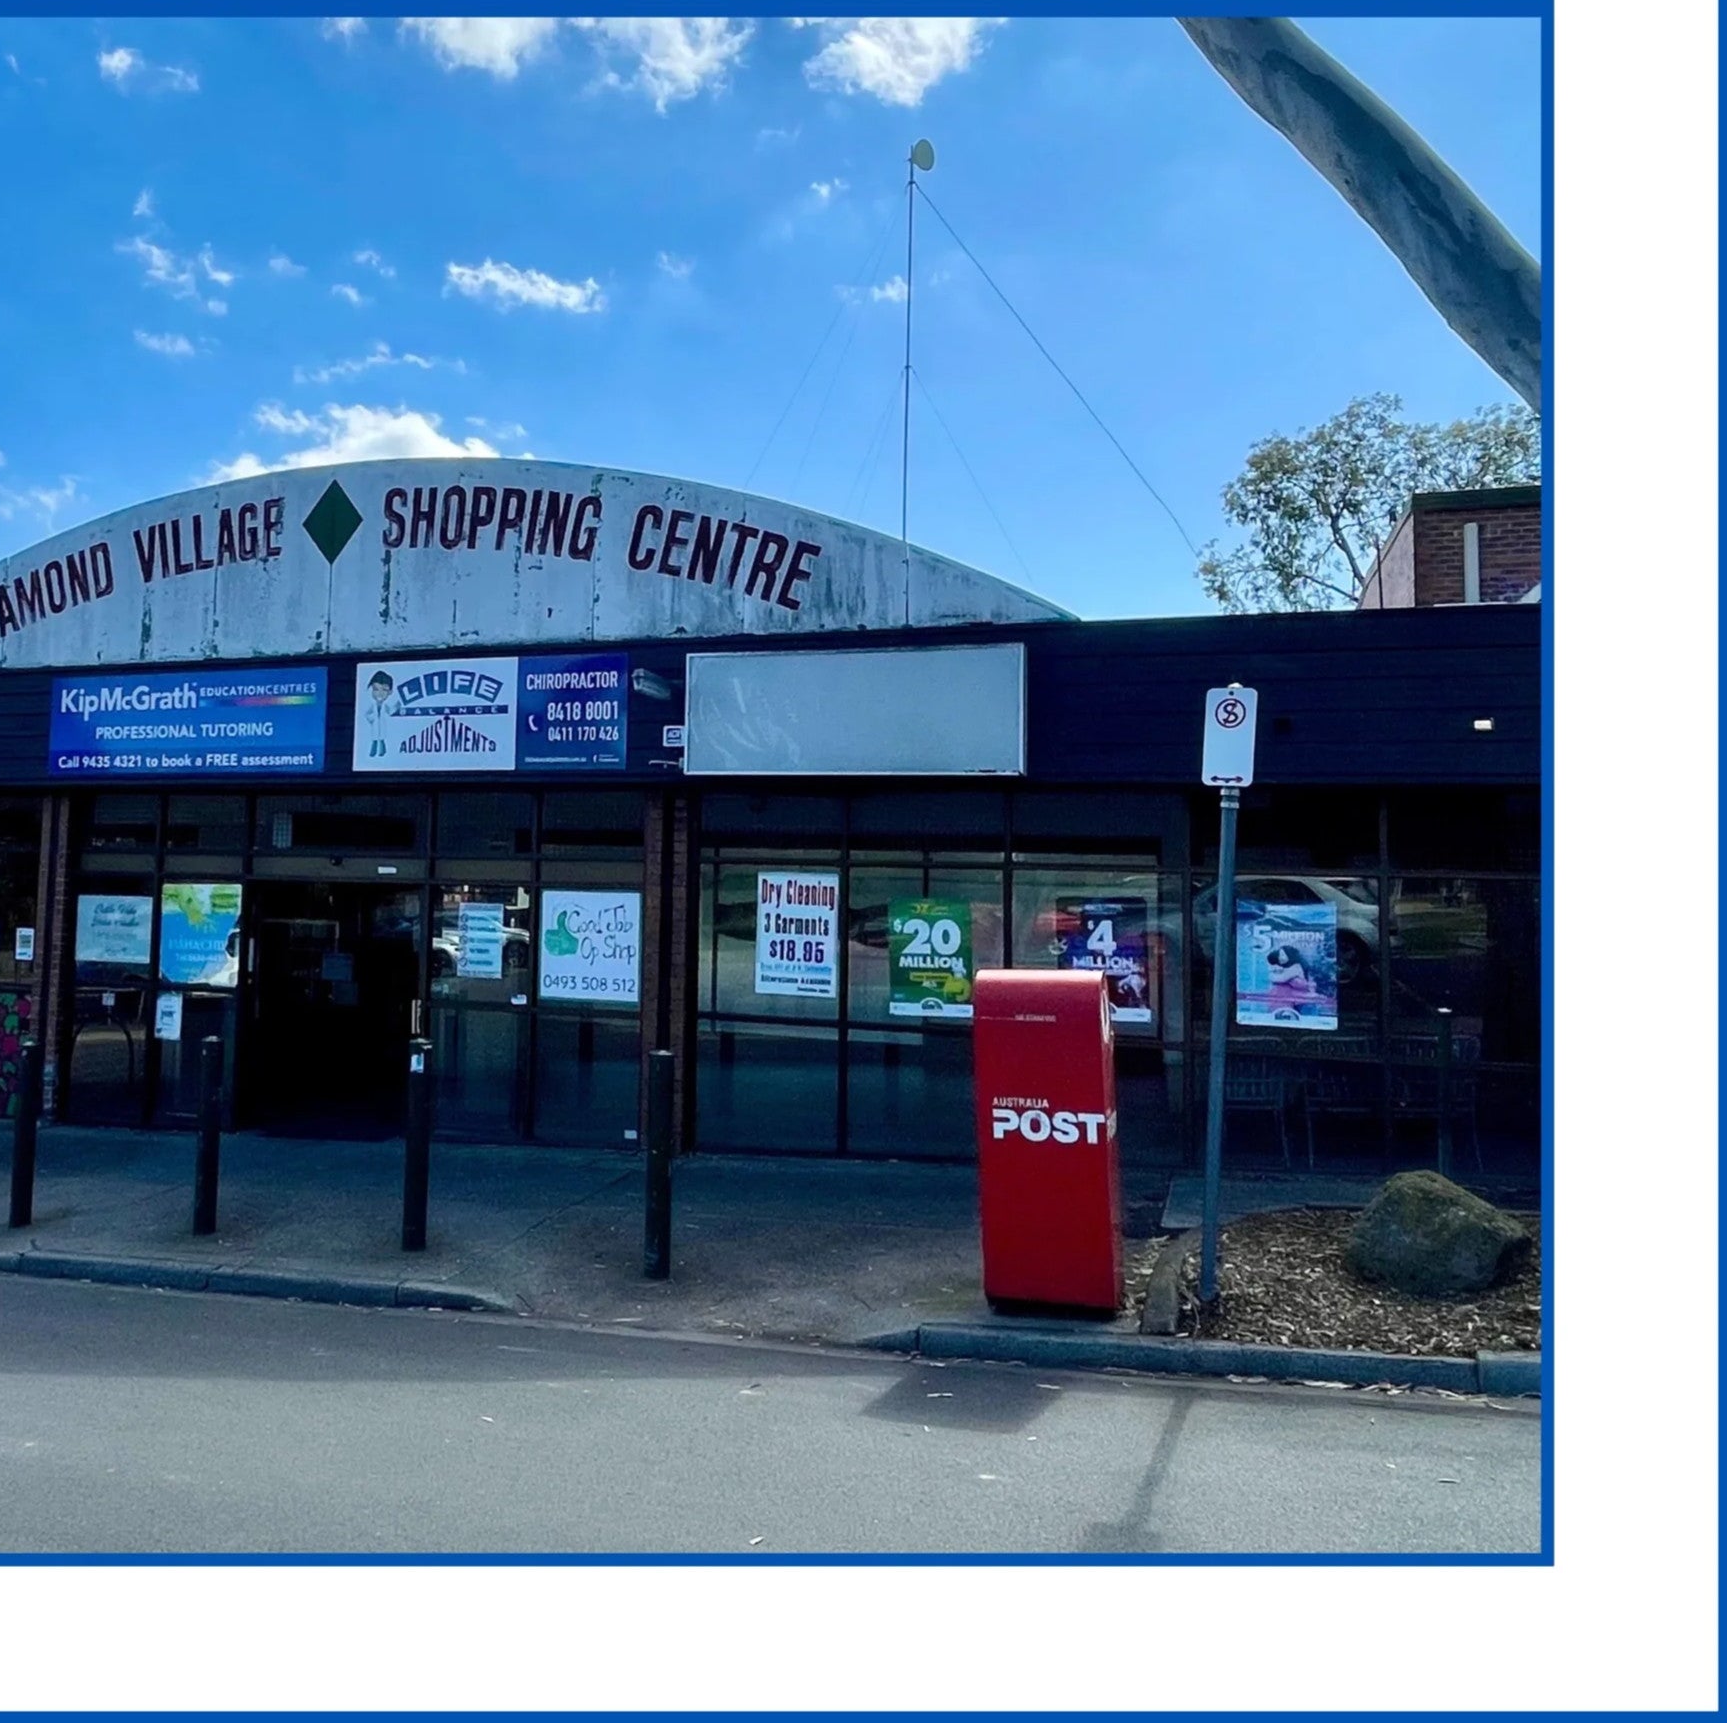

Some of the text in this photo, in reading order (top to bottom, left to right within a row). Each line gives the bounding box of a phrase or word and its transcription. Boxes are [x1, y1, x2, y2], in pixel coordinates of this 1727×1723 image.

[133, 497, 286, 583] VILLAGE
[383, 484, 822, 611] SHOPPING CENTRE
[399, 671, 501, 704] LIFE
[526, 671, 619, 690] CHIROPRACTOR
[60, 682, 198, 721] KipMcGrath
[400, 705, 500, 715] BALANCE
[547, 701, 619, 722] 8418 8001
[95, 722, 274, 741] PROFESSIONAL TUTORING
[399, 716, 497, 754] ADJUSTMENTS
[548, 726, 619, 742] 0411 170 426
[58, 753, 314, 769] Call 9435 4321 to book a FREE assessment
[761, 879, 836, 911] Dry Cleaning
[764, 913, 829, 937] 3 Garments
[899, 955, 966, 969] MILLION
[1072, 955, 1135, 971] MILLION
[543, 974, 636, 993] 0493 508 512
[992, 1096, 1050, 1109] AUSTRALIA
[992, 1108, 1106, 1145] POST
